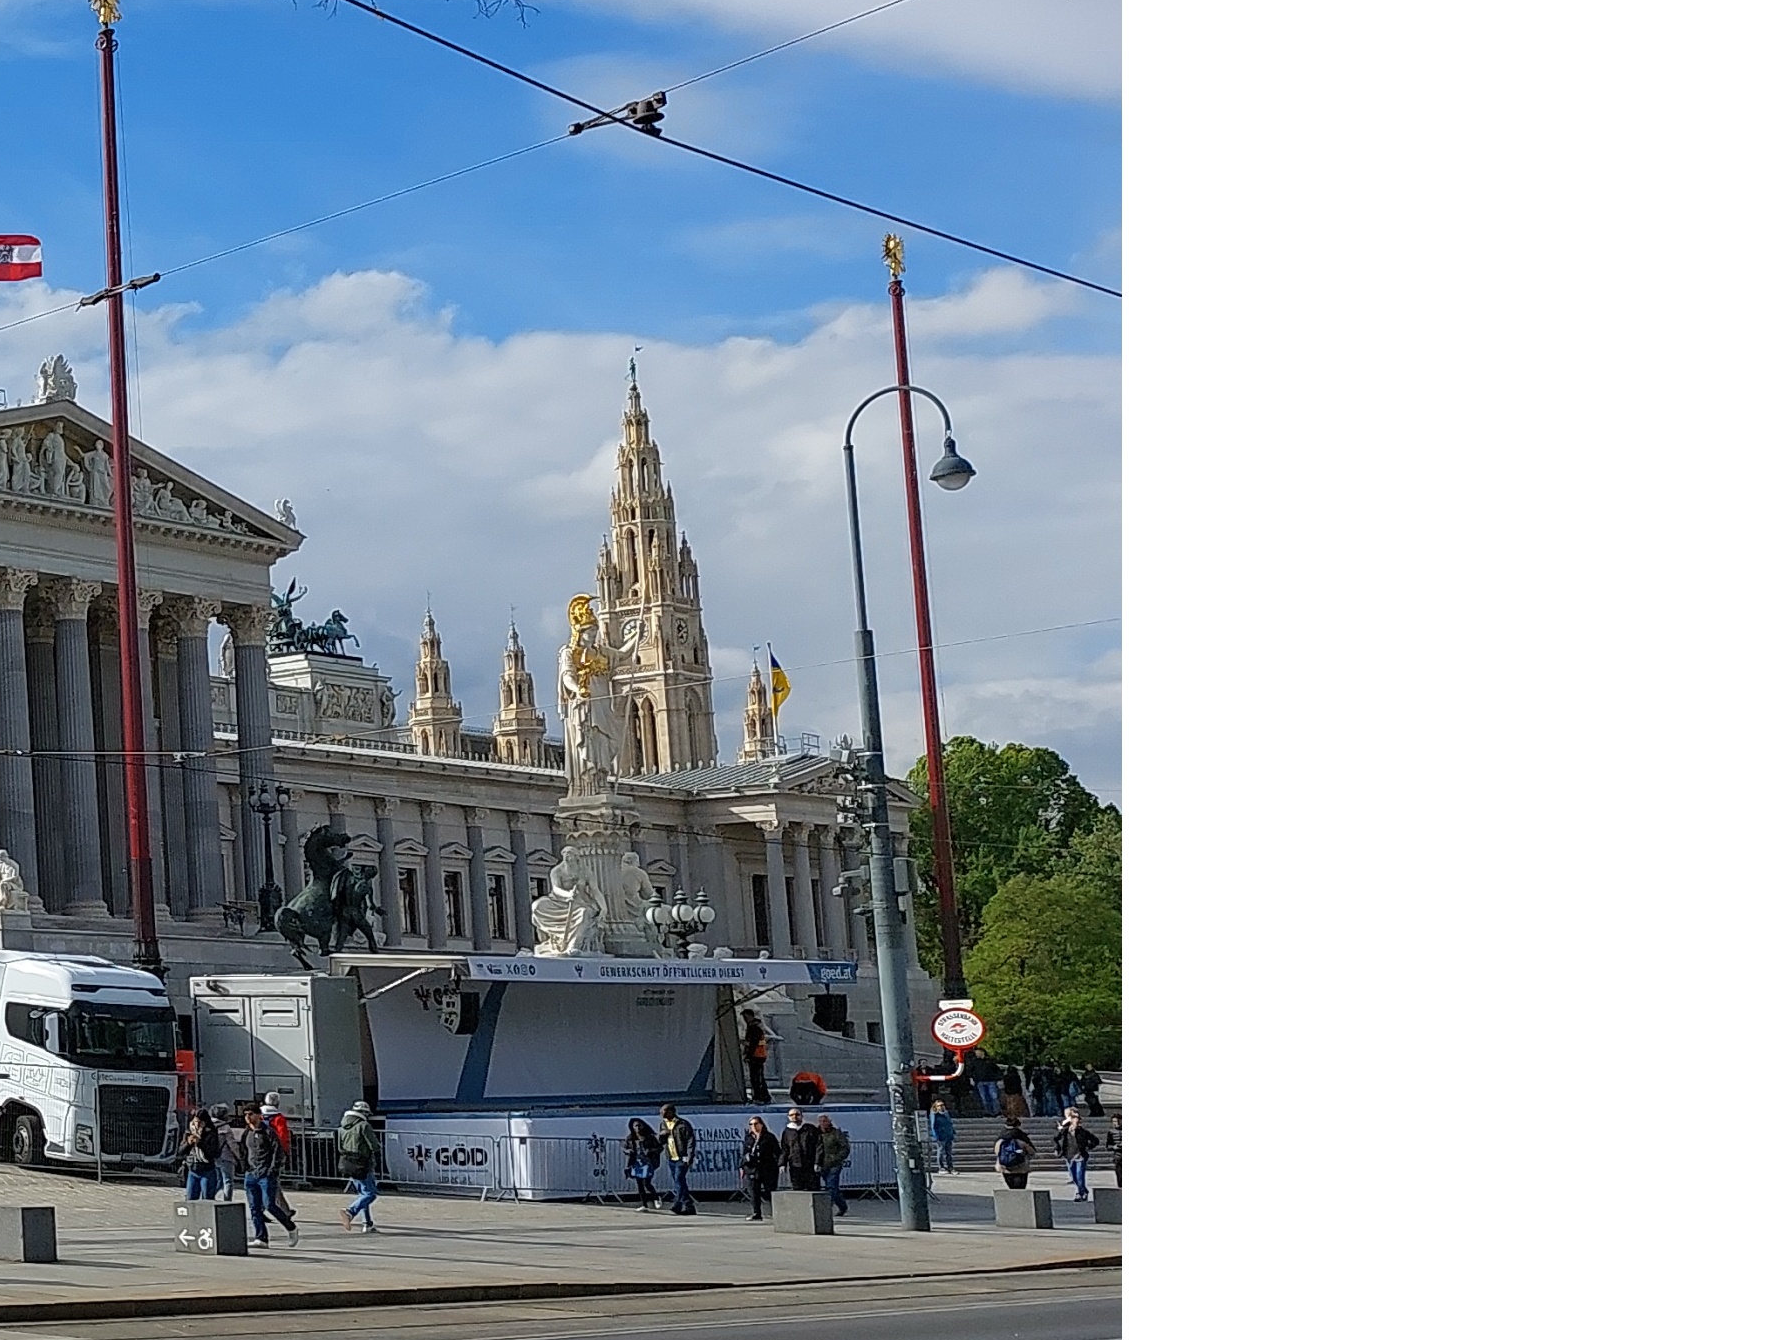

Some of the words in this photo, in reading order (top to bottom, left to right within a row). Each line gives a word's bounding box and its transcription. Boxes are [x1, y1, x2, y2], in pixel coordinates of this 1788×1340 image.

[600, 966, 660, 978] GEWERKSCHAFT
[662, 964, 716, 978] ÖFFENTLICHER
[719, 967, 744, 978] DIENST
[820, 966, 853, 982] goed.at
[937, 1012, 979, 1026] STRASSENBAHN
[940, 1031, 978, 1044] HALTESTELLE
[435, 1143, 488, 1166] GÖD
